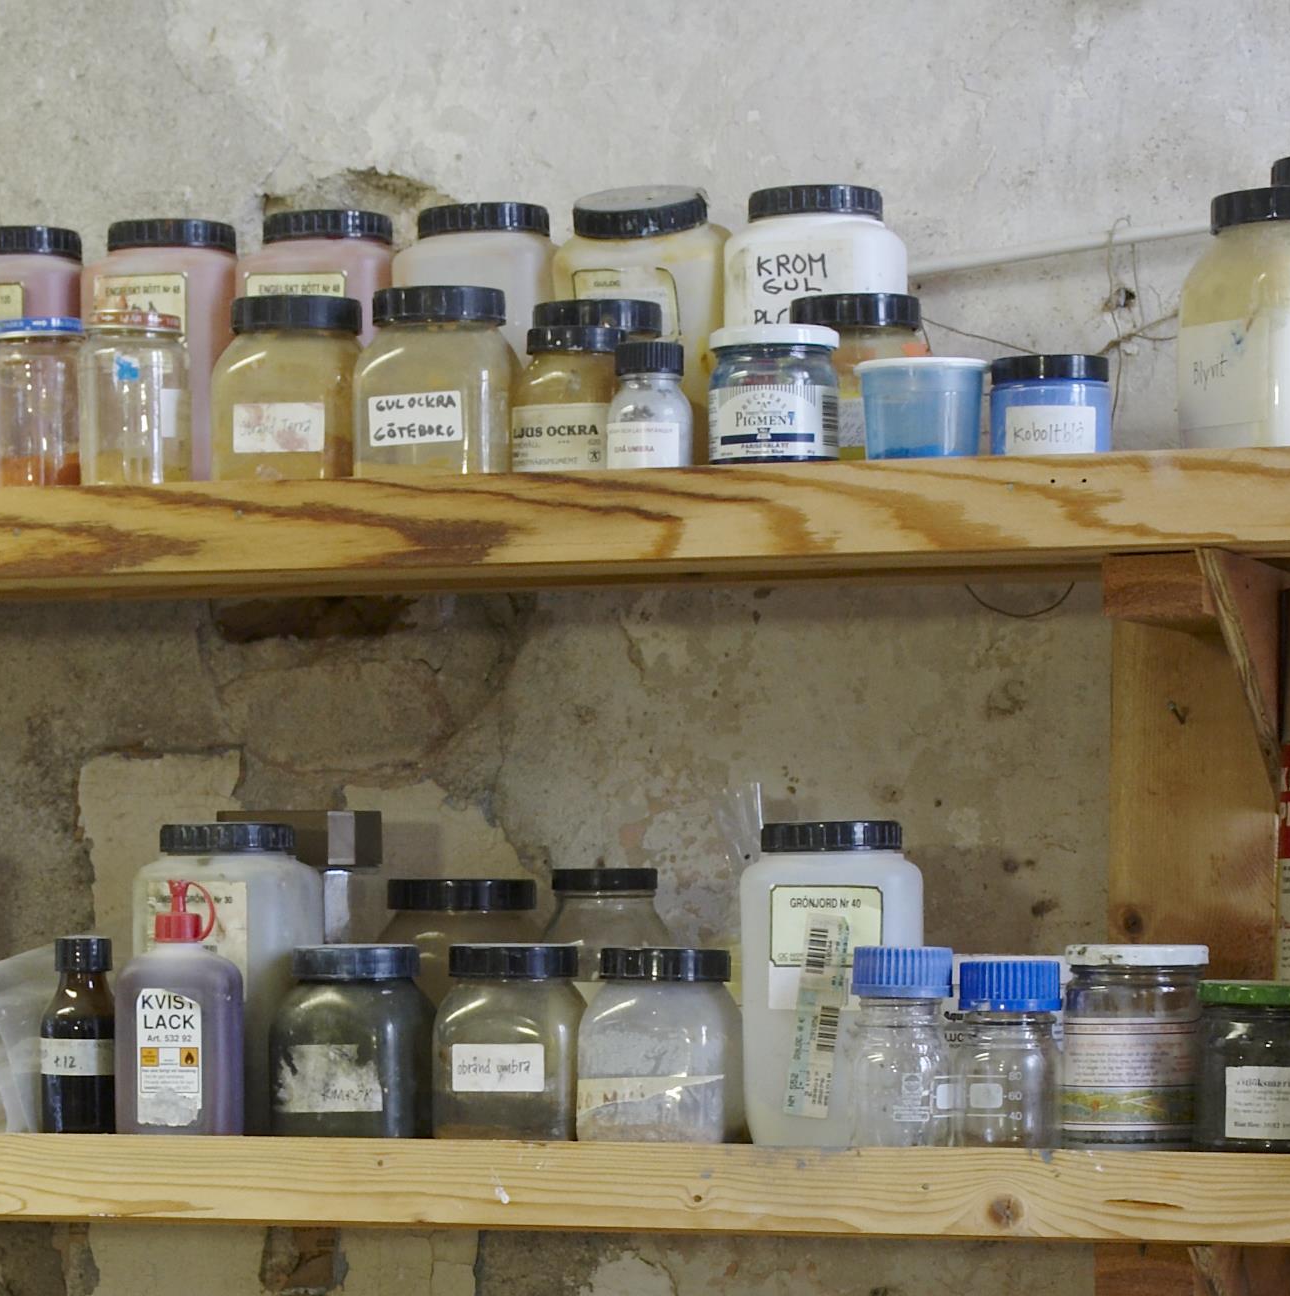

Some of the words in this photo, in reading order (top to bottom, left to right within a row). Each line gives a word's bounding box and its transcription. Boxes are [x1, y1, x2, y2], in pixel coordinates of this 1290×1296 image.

[756, 253, 828, 278] KROM
[762, 277, 823, 295] GUL
[376, 399, 404, 411] GUL
[407, 395, 457, 409] OCKRA
[735, 411, 796, 428] PIGMENT
[373, 422, 456, 441] GÖTEBORG
[512, 426, 544, 439] LJUS
[546, 424, 599, 437] OCKRA
[789, 896, 838, 909] GRÖNJORD
[840, 898, 849, 908] Nr
[851, 898, 862, 908] 40
[143, 1014, 195, 1030] LACK
[146, 1034, 162, 1043] Art.
[164, 1034, 181, 1043] 532
[182, 1034, 193, 1043] 92
[1008, 1091, 1022, 1101] 60
[1008, 1111, 1023, 1121] 40
